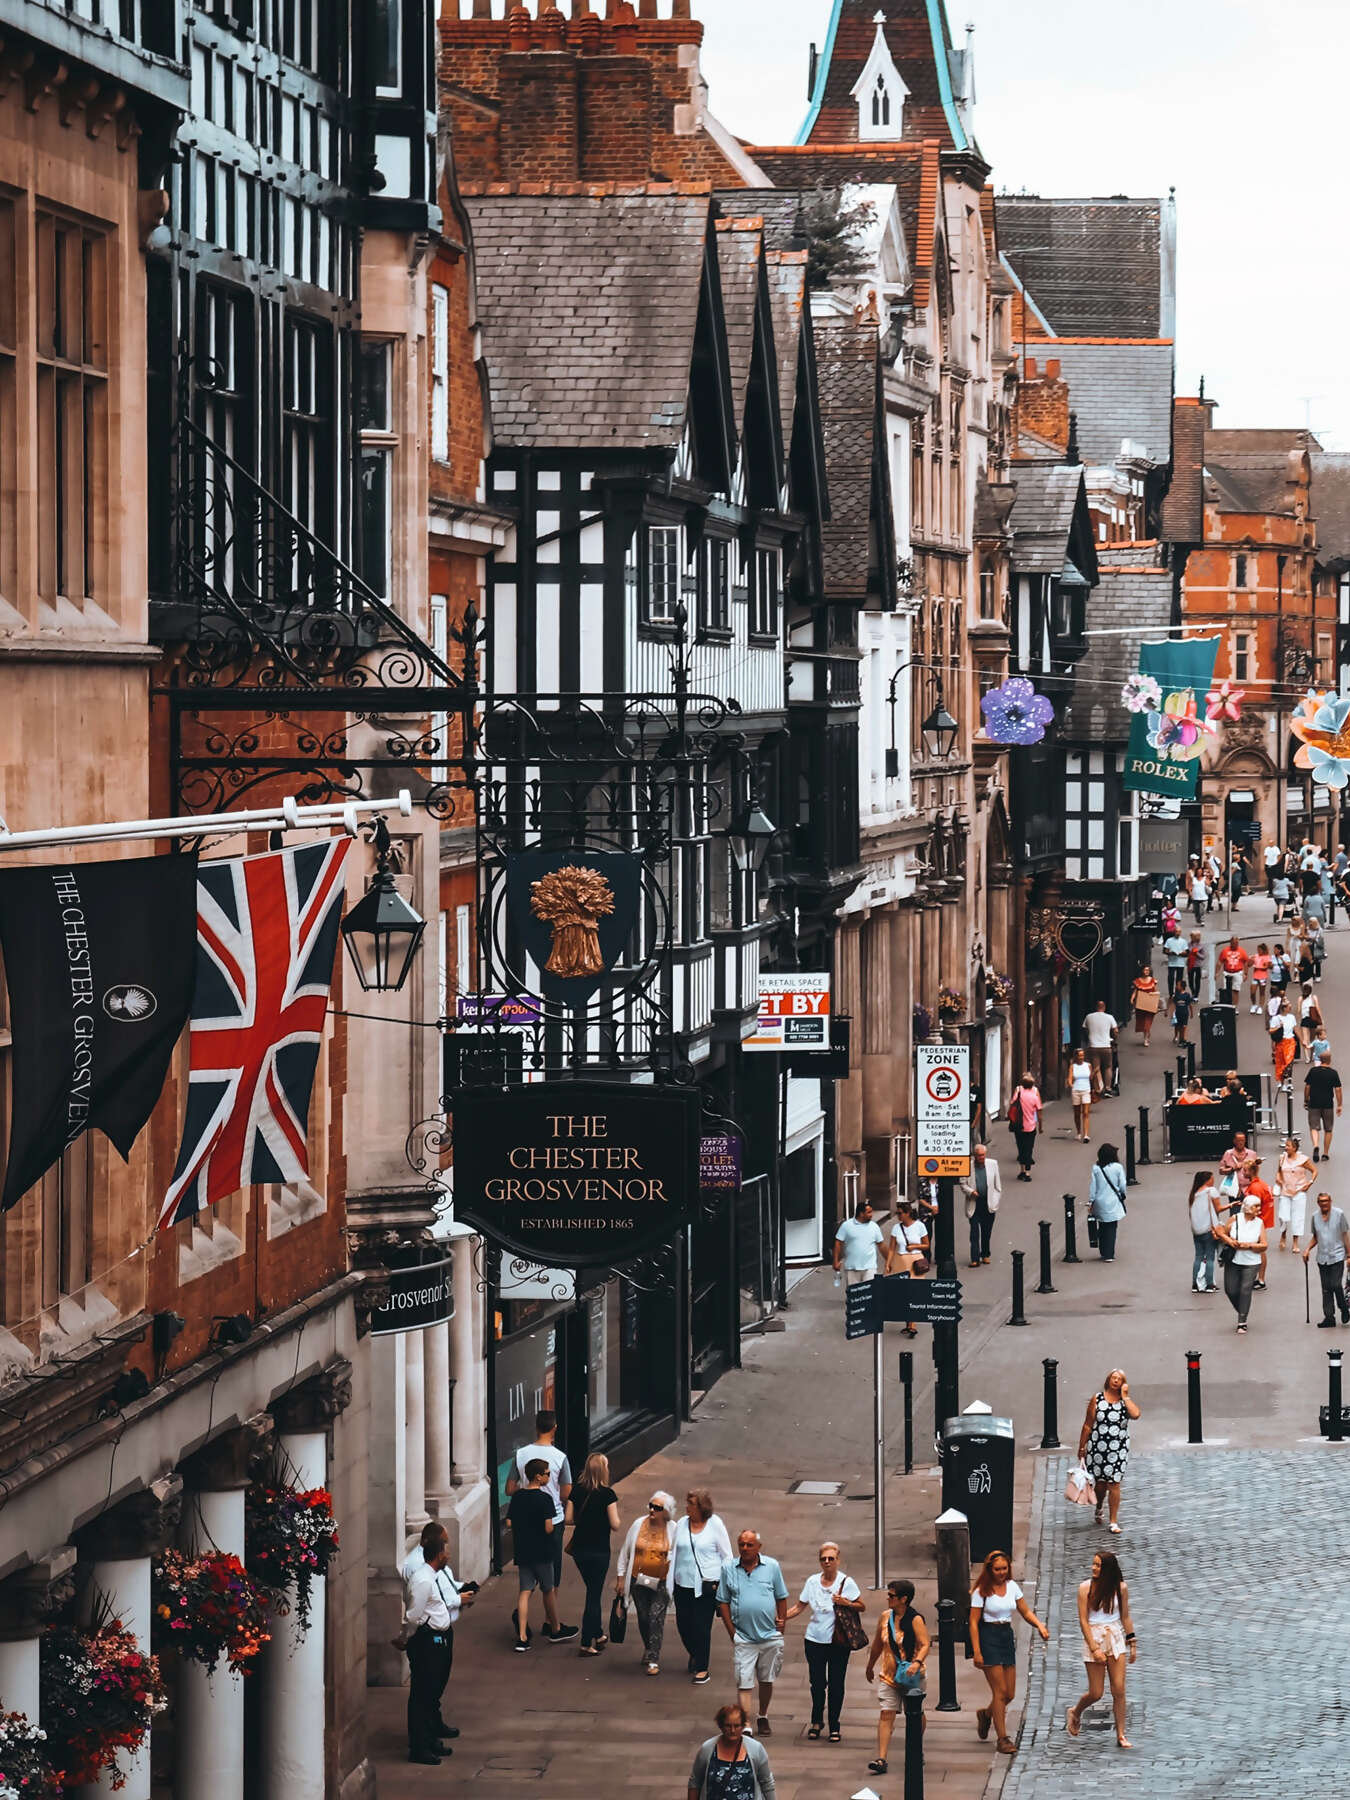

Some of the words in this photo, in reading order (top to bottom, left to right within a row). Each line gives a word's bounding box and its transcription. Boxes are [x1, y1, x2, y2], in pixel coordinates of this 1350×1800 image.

[1131, 760, 1189, 781] ROLEX
[52, 872, 81, 904] THE
[61, 908, 94, 1008] CHESTER
[757, 995, 784, 1014] ET
[792, 994, 824, 1014] BY
[926, 1055, 960, 1064] ZONE
[64, 1014, 94, 1150] GROSVEN
[546, 1115, 608, 1137] THE
[509, 1147, 644, 1170] CHESTER
[485, 1178, 669, 1202] GROSVENOR
[521, 1218, 606, 1229] ESTABLISHED
[610, 1218, 634, 1229] 1865
